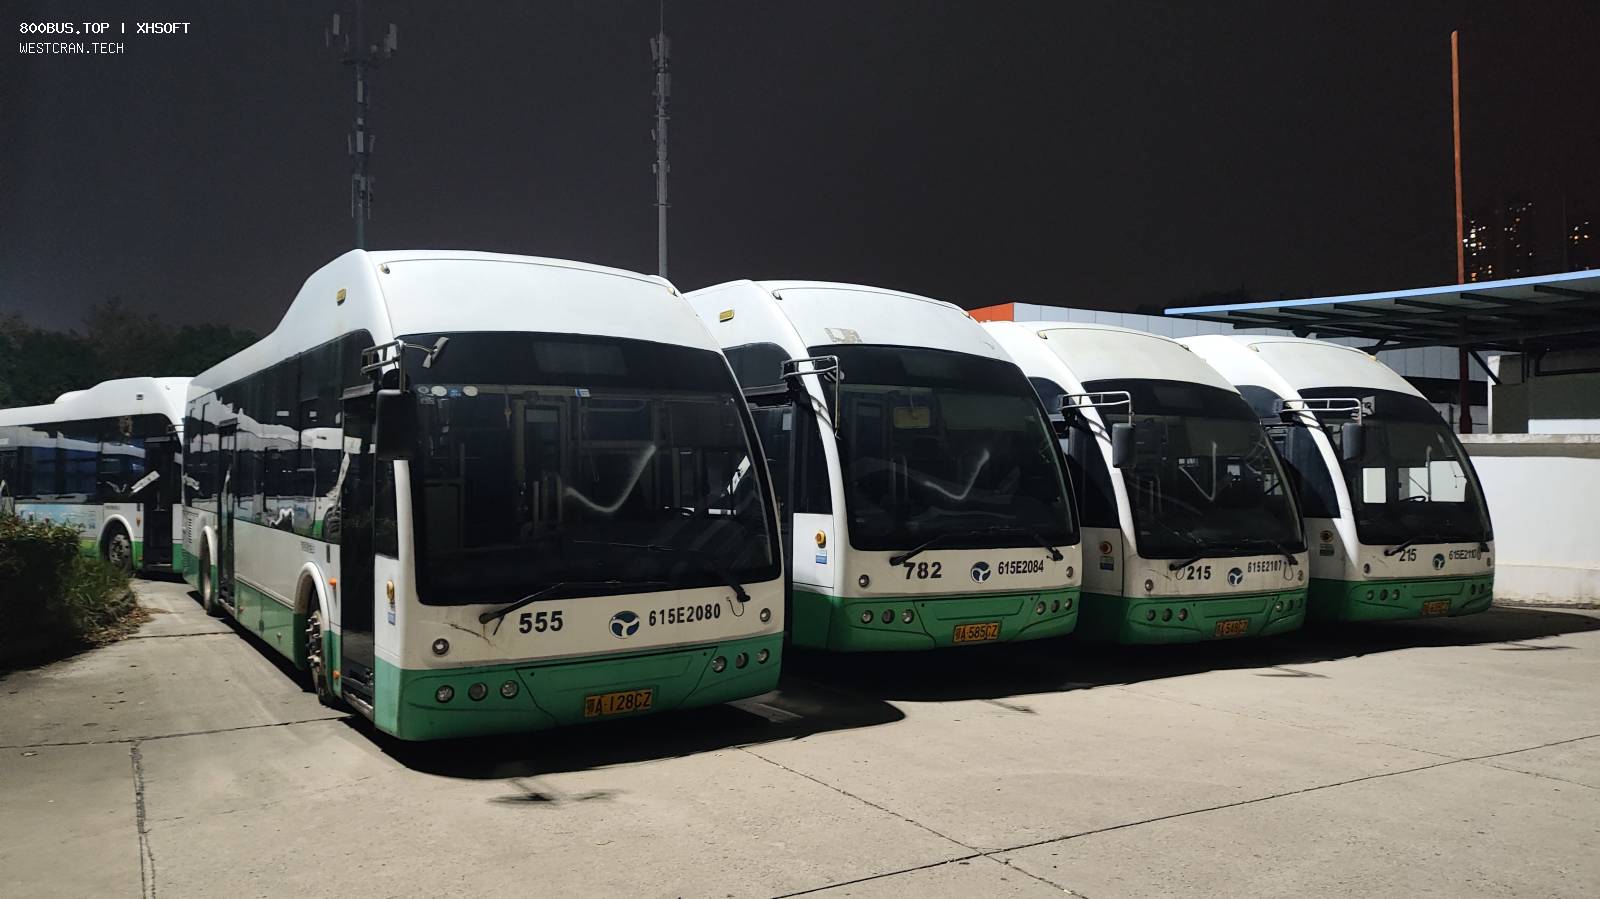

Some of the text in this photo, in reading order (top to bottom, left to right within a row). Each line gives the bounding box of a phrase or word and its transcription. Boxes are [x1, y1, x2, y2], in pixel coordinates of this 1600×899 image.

[1399, 548, 1417, 562] 215
[903, 561, 942, 580] 782
[998, 559, 1045, 575] 615E2084
[1186, 565, 1212, 581] 215
[519, 610, 563, 634] 555
[648, 603, 721, 627] 615E2080
